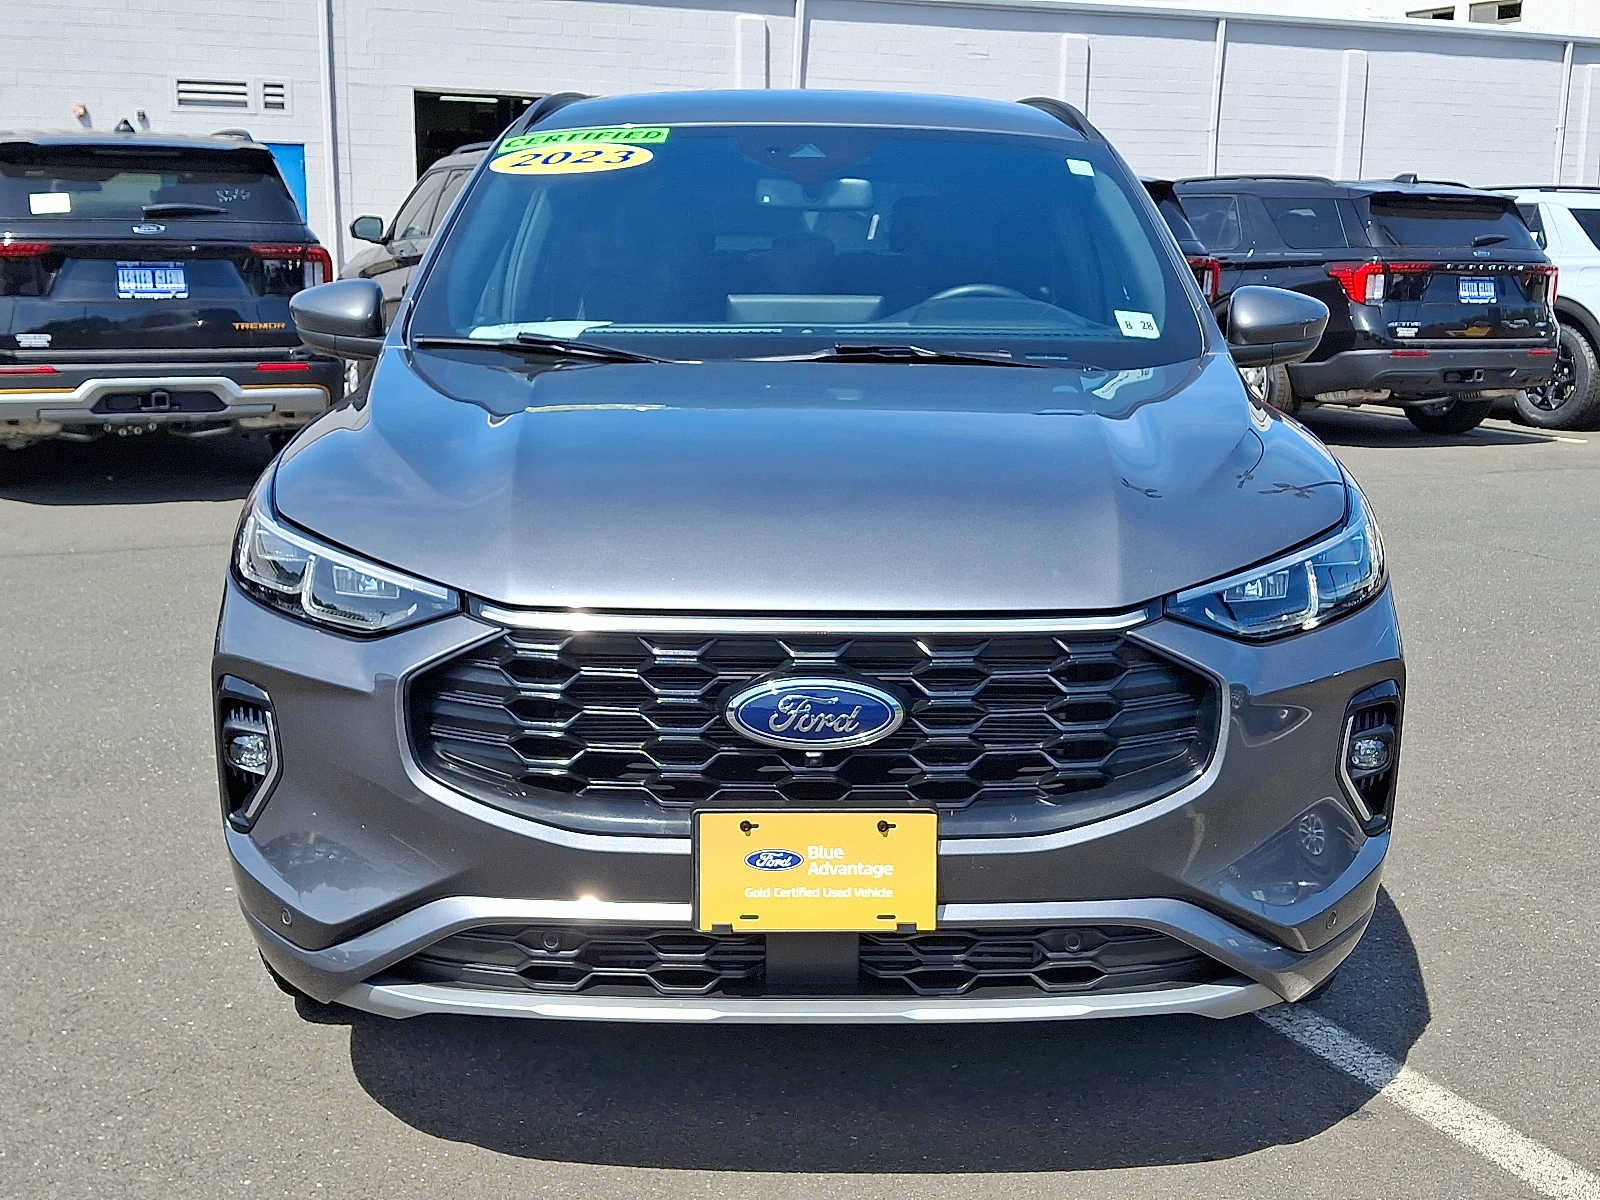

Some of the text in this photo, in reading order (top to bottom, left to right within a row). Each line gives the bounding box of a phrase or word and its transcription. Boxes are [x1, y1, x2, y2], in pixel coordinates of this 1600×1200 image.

[504, 130, 663, 149] CERTIFIED
[509, 150, 636, 168] 2023
[232, 322, 286, 331] TREMOR
[768, 693, 862, 734] Ford
[755, 851, 793, 868] Ford
[807, 846, 845, 860] Blue
[807, 862, 894, 879] Advantage
[744, 887, 893, 899] Gold Certified Used Vehicle
